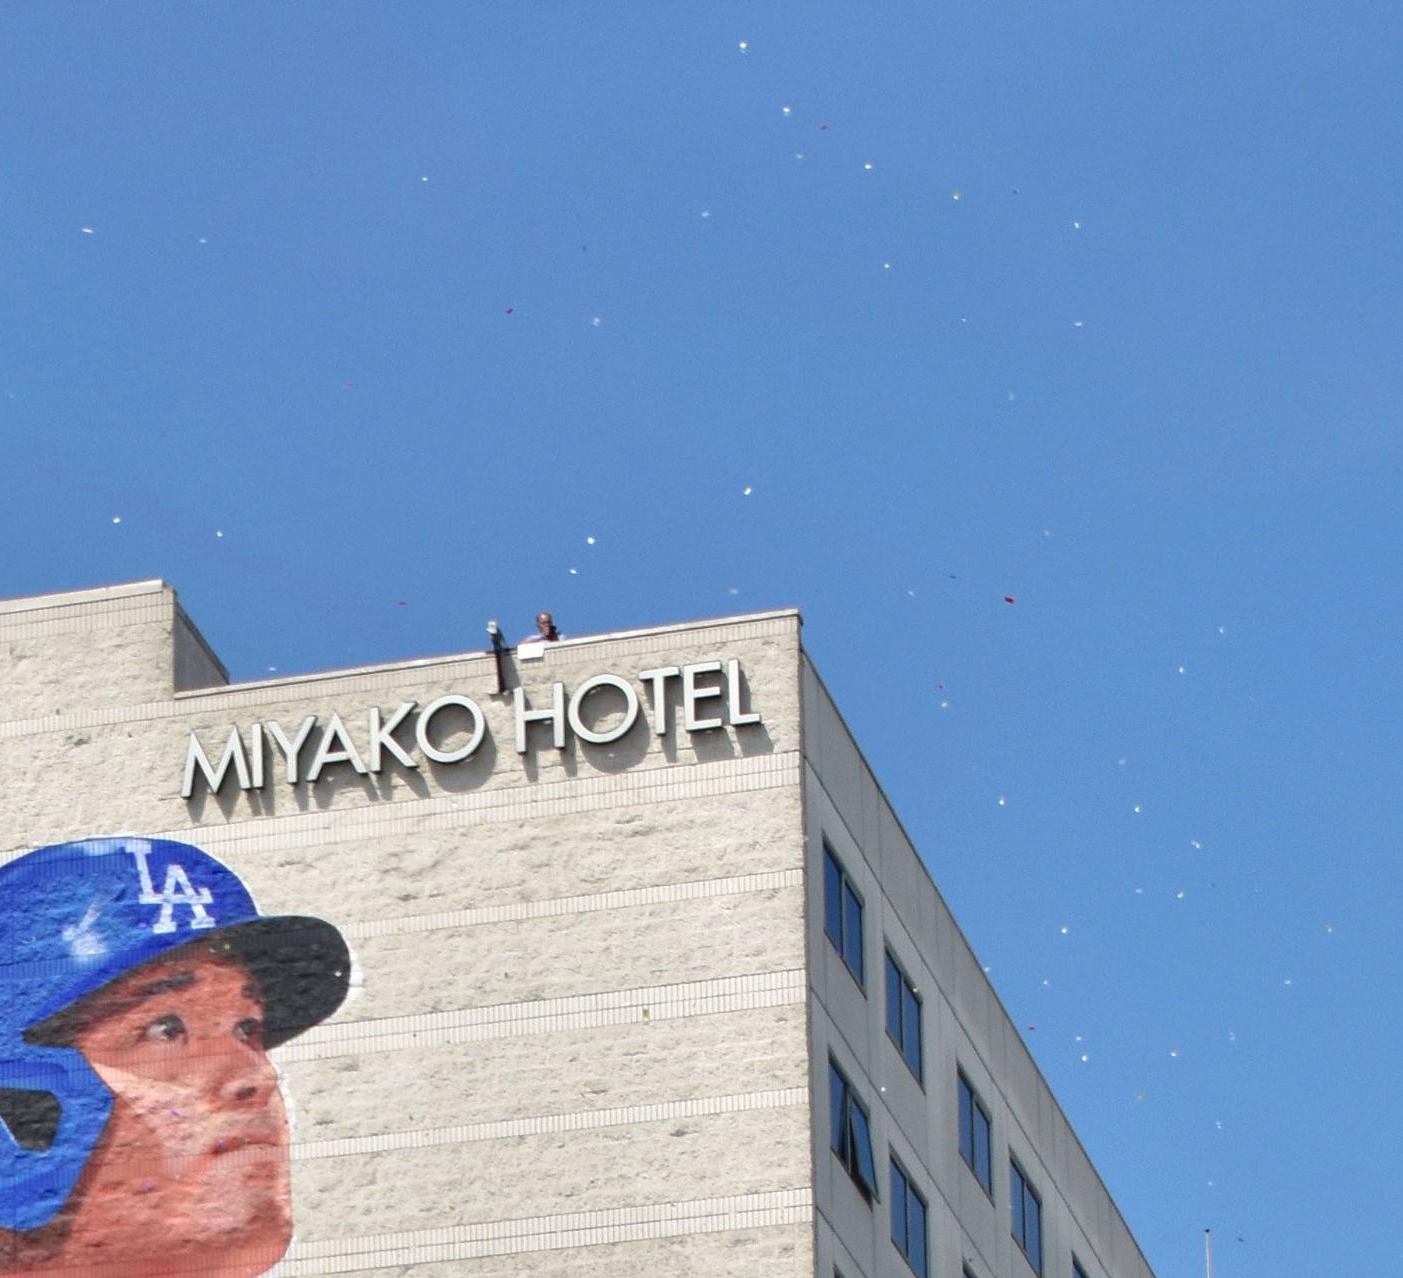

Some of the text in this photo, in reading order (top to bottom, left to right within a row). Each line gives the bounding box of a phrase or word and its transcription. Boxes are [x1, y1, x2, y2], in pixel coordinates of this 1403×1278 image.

[181, 658, 760, 799] MIYAKO HOTEL
[125, 840, 215, 934] LA
